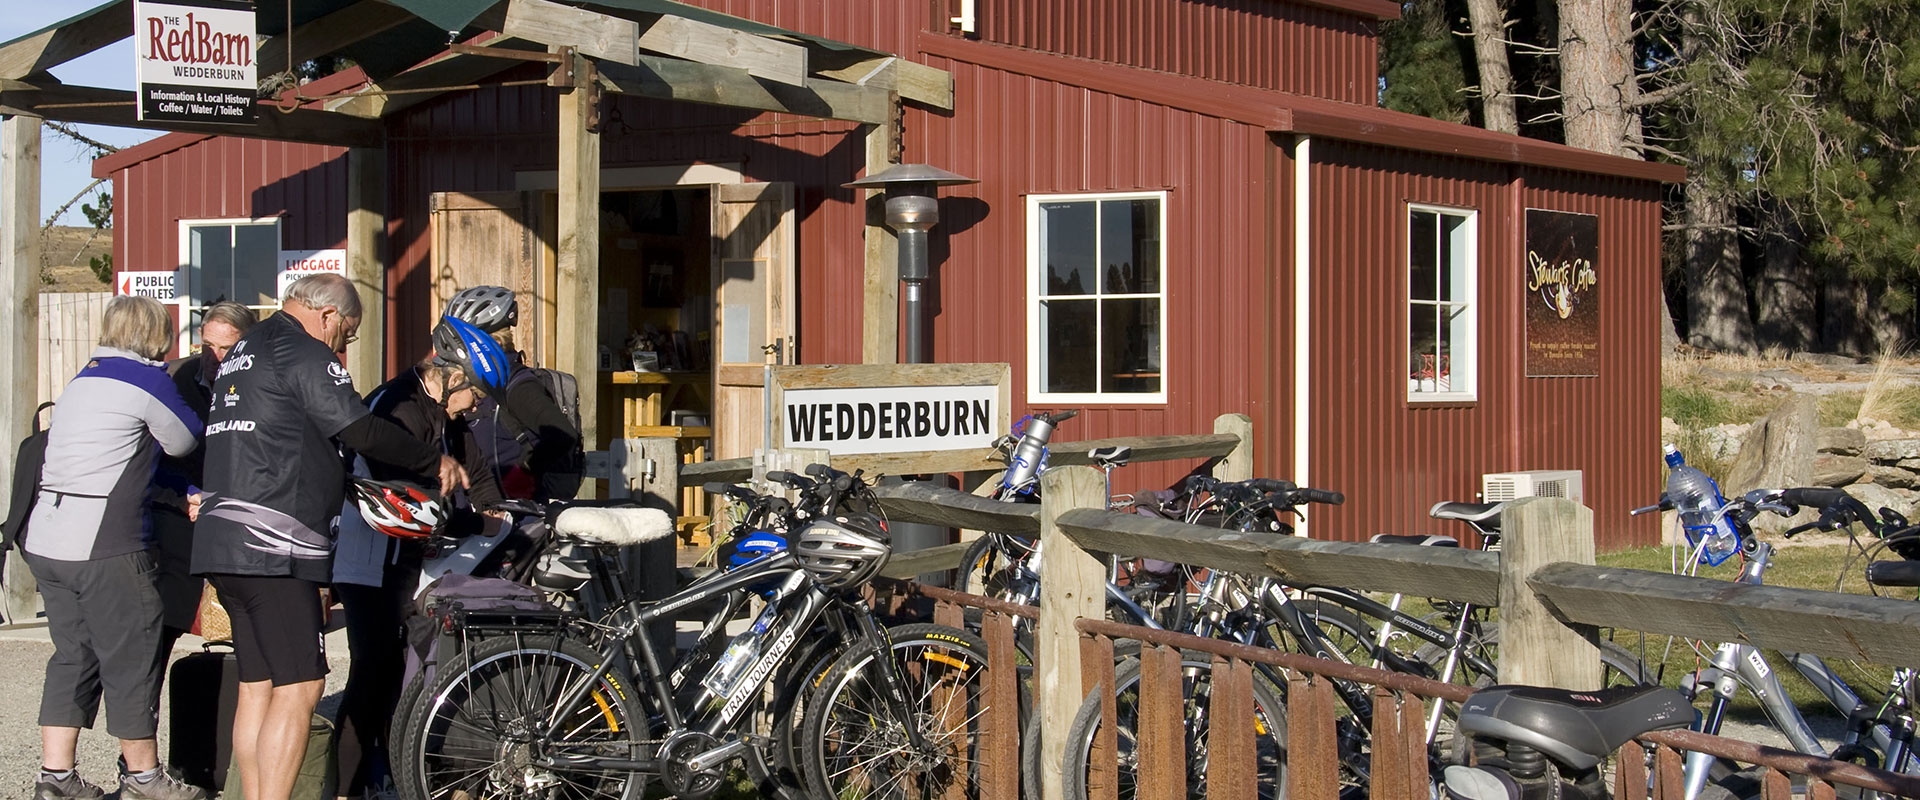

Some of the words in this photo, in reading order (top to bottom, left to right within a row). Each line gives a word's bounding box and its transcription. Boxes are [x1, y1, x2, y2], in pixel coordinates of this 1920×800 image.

[164, 16, 180, 26] THE
[147, 12, 252, 67] RedBarn
[173, 66, 245, 80] WEDDERBURN
[150, 90, 195, 101] Information
[196, 92, 203, 101] &
[204, 93, 223, 103] Local
[225, 94, 251, 106] History
[159, 102, 184, 113] Coffee
[191, 104, 213, 115] Water
[220, 106, 244, 116] Toilets
[286, 259, 341, 271] LUGGAGE
[136, 276, 174, 287] PUBLIC
[135, 288, 174, 299] TOILETS
[788, 400, 990, 442] WEDDERBURN
[724, 688, 751, 718] TRAIL
[750, 632, 795, 689] JOURNEYS
